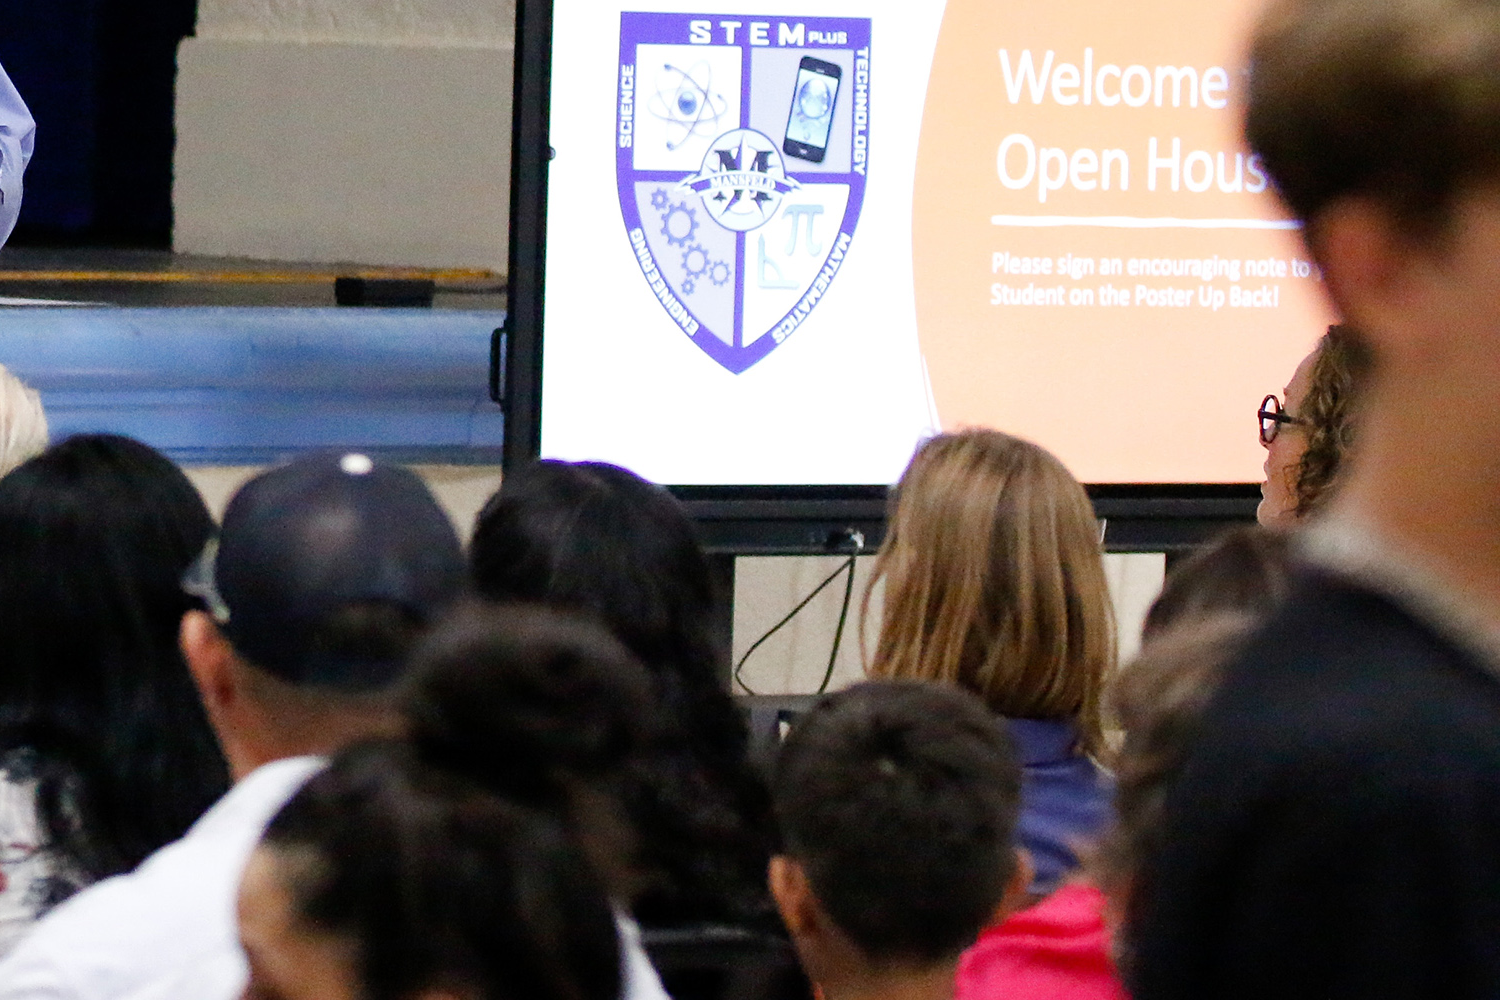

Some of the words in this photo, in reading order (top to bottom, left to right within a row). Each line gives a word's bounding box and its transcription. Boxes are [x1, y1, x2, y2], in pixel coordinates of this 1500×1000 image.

[688, 19, 806, 47] STEM
[807, 30, 848, 45] PLUS
[619, 63, 636, 149] SCIENCE
[852, 46, 871, 176] TECHNOLOGY
[997, 46, 1230, 110] Welcome
[709, 174, 777, 191] MANSFELD
[996, 132, 1130, 204] Open
[1147, 136, 1283, 195] Hous
[629, 227, 701, 337] ENGINEERING
[771, 231, 853, 345] MATHEMATICS
[990, 282, 1066, 306] Student
[1069, 287, 1095, 306] on
[1098, 283, 1131, 306] the
[1134, 284, 1195, 307] Poster
[1198, 285, 1226, 312] Up
[1229, 285, 1280, 308] Back!
[991, 251, 1053, 276] Please
[1056, 252, 1095, 280] sign
[1099, 257, 1123, 276] an
[1126, 254, 1241, 282] encouraging
[1245, 258, 1287, 278] note
[1291, 257, 1311, 278] to
